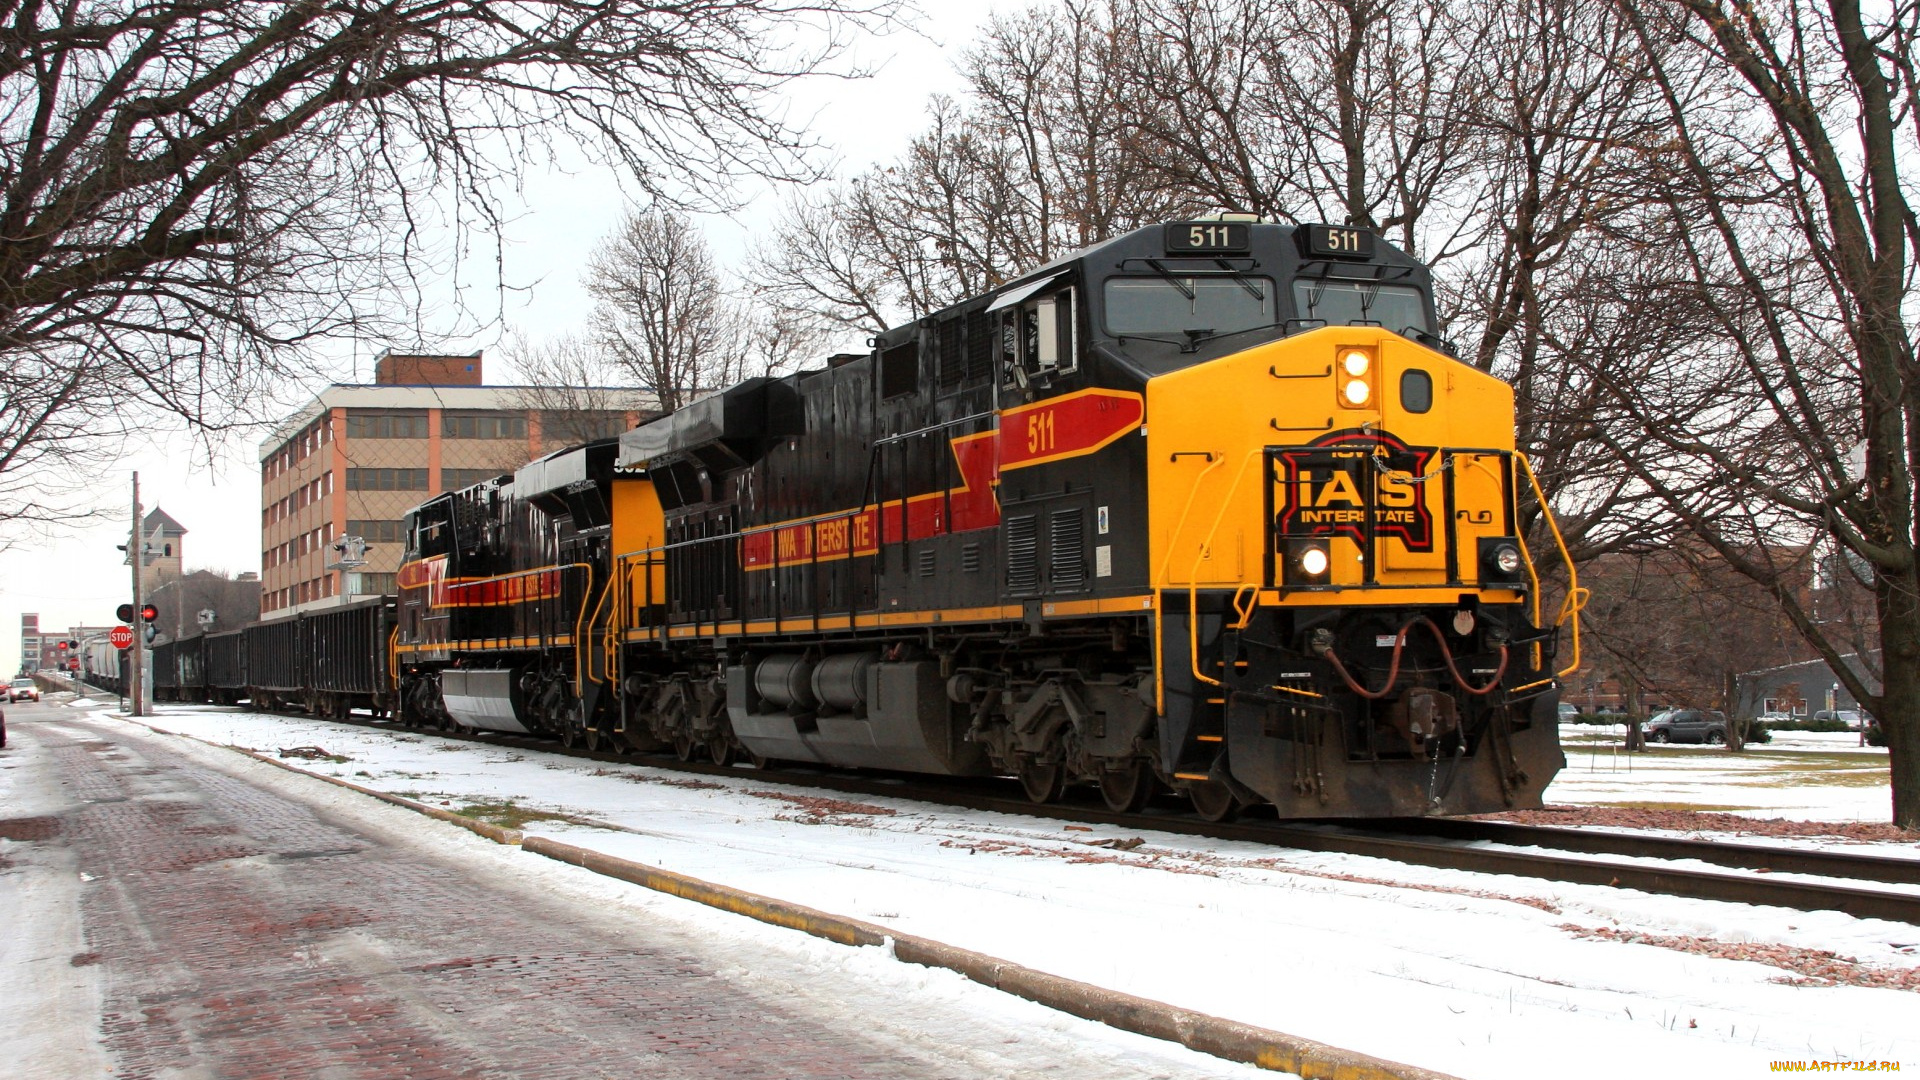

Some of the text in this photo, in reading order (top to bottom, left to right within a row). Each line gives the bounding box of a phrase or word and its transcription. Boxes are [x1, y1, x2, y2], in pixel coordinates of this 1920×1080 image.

[1190, 226, 1230, 247] 511
[1328, 230, 1359, 251] 511
[1028, 410, 1055, 453] 511
[1299, 470, 1415, 507] IAS
[805, 515, 869, 555] INTERSTTE
[111, 632, 132, 642] STOP
